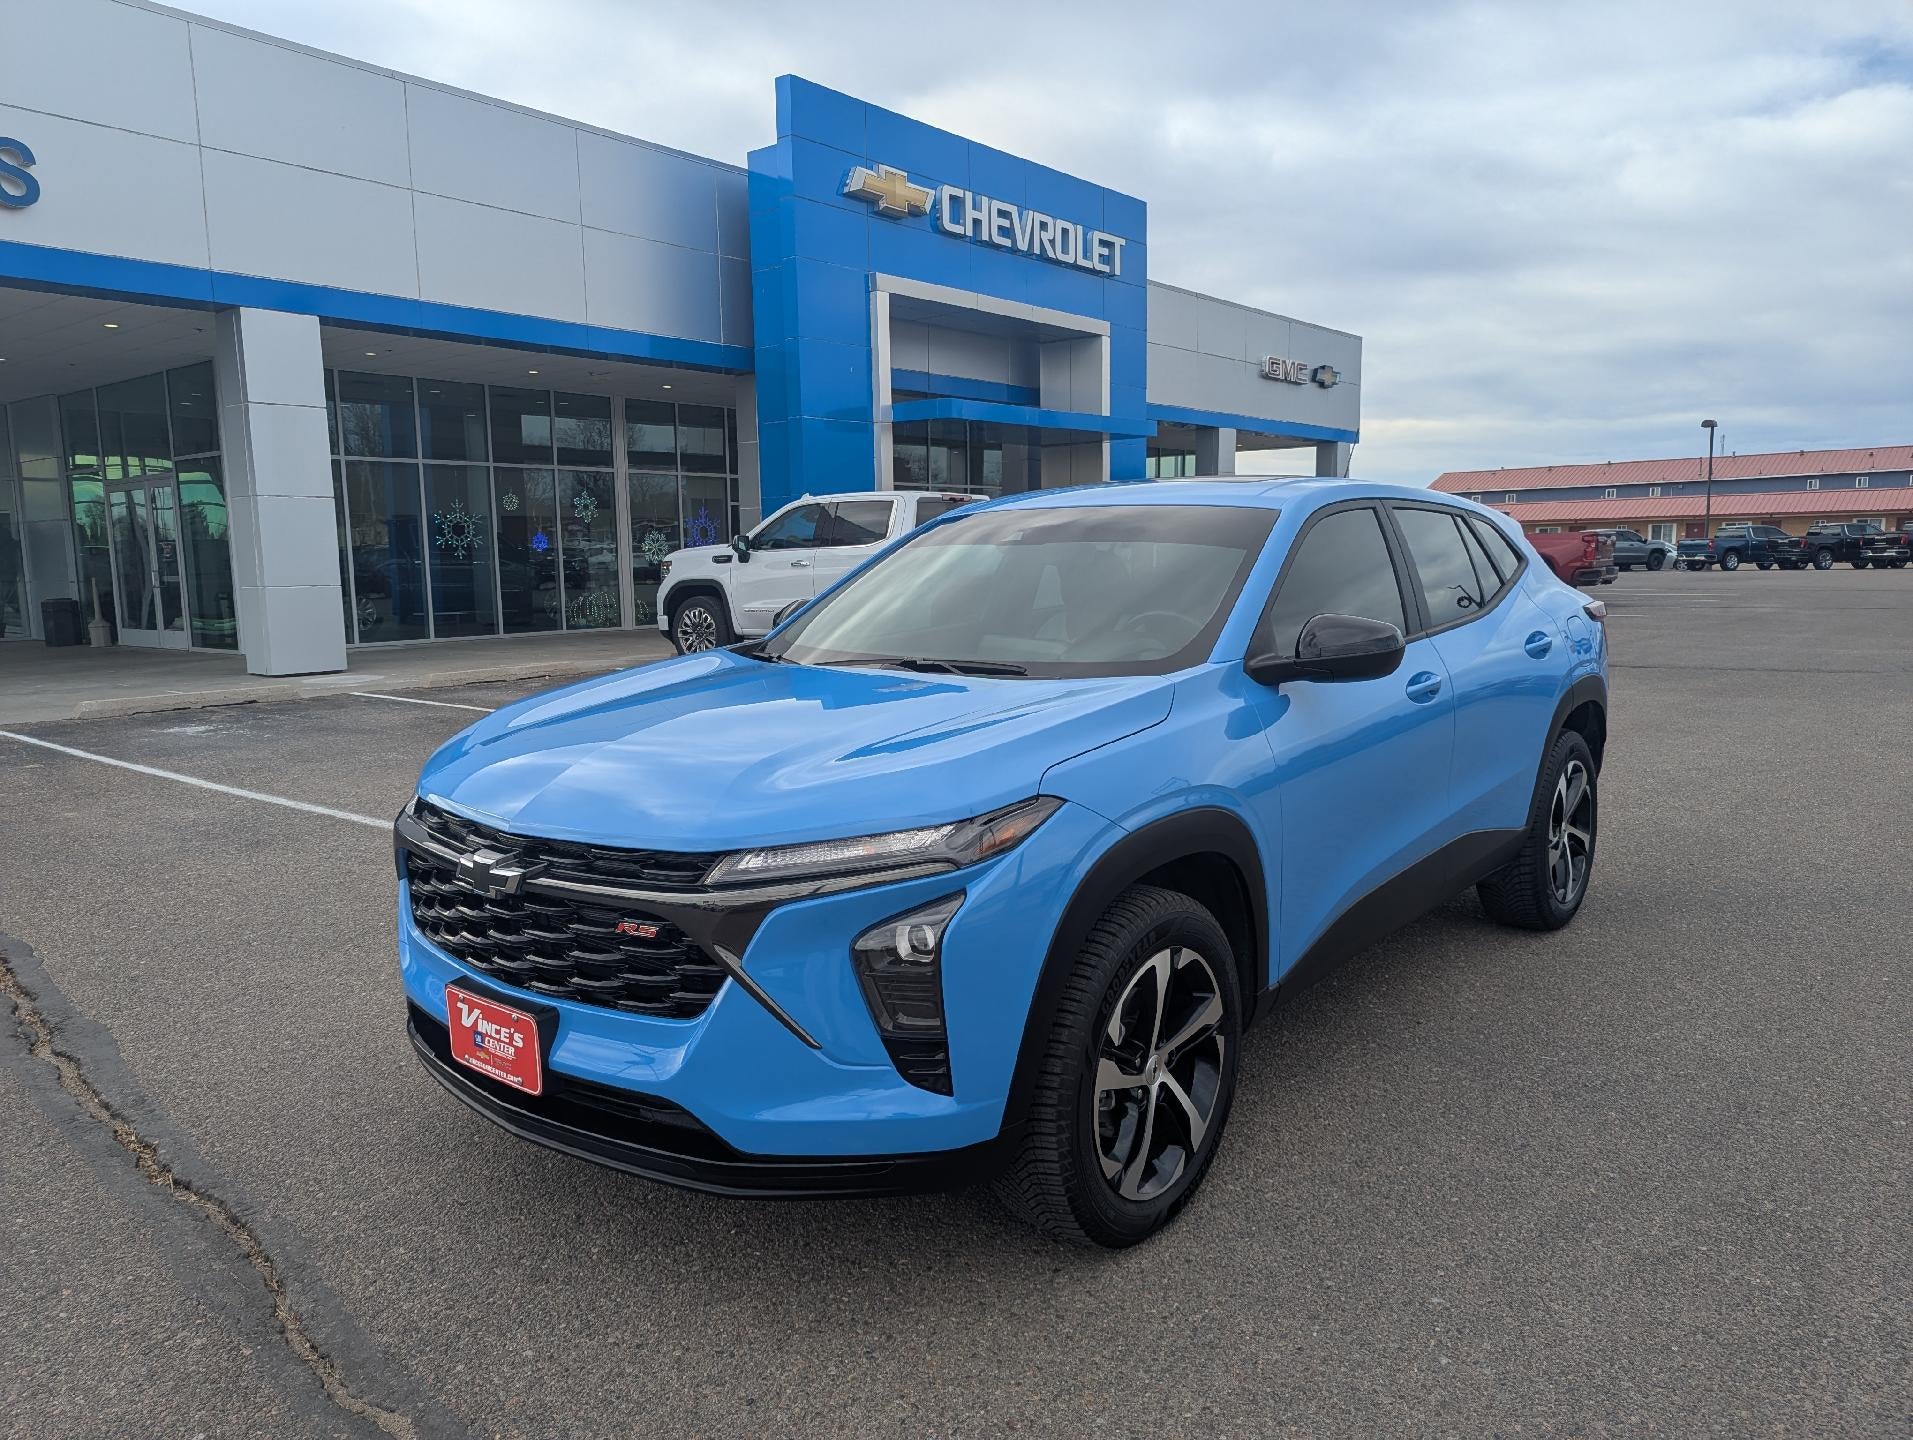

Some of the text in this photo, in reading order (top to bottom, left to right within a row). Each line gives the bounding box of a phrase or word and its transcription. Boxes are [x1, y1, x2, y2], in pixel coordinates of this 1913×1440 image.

[937, 183, 1127, 277] CHEVROLET
[1263, 355, 1309, 384] GMC
[615, 922, 658, 938] RS
[484, 1036, 516, 1057] CENTER
